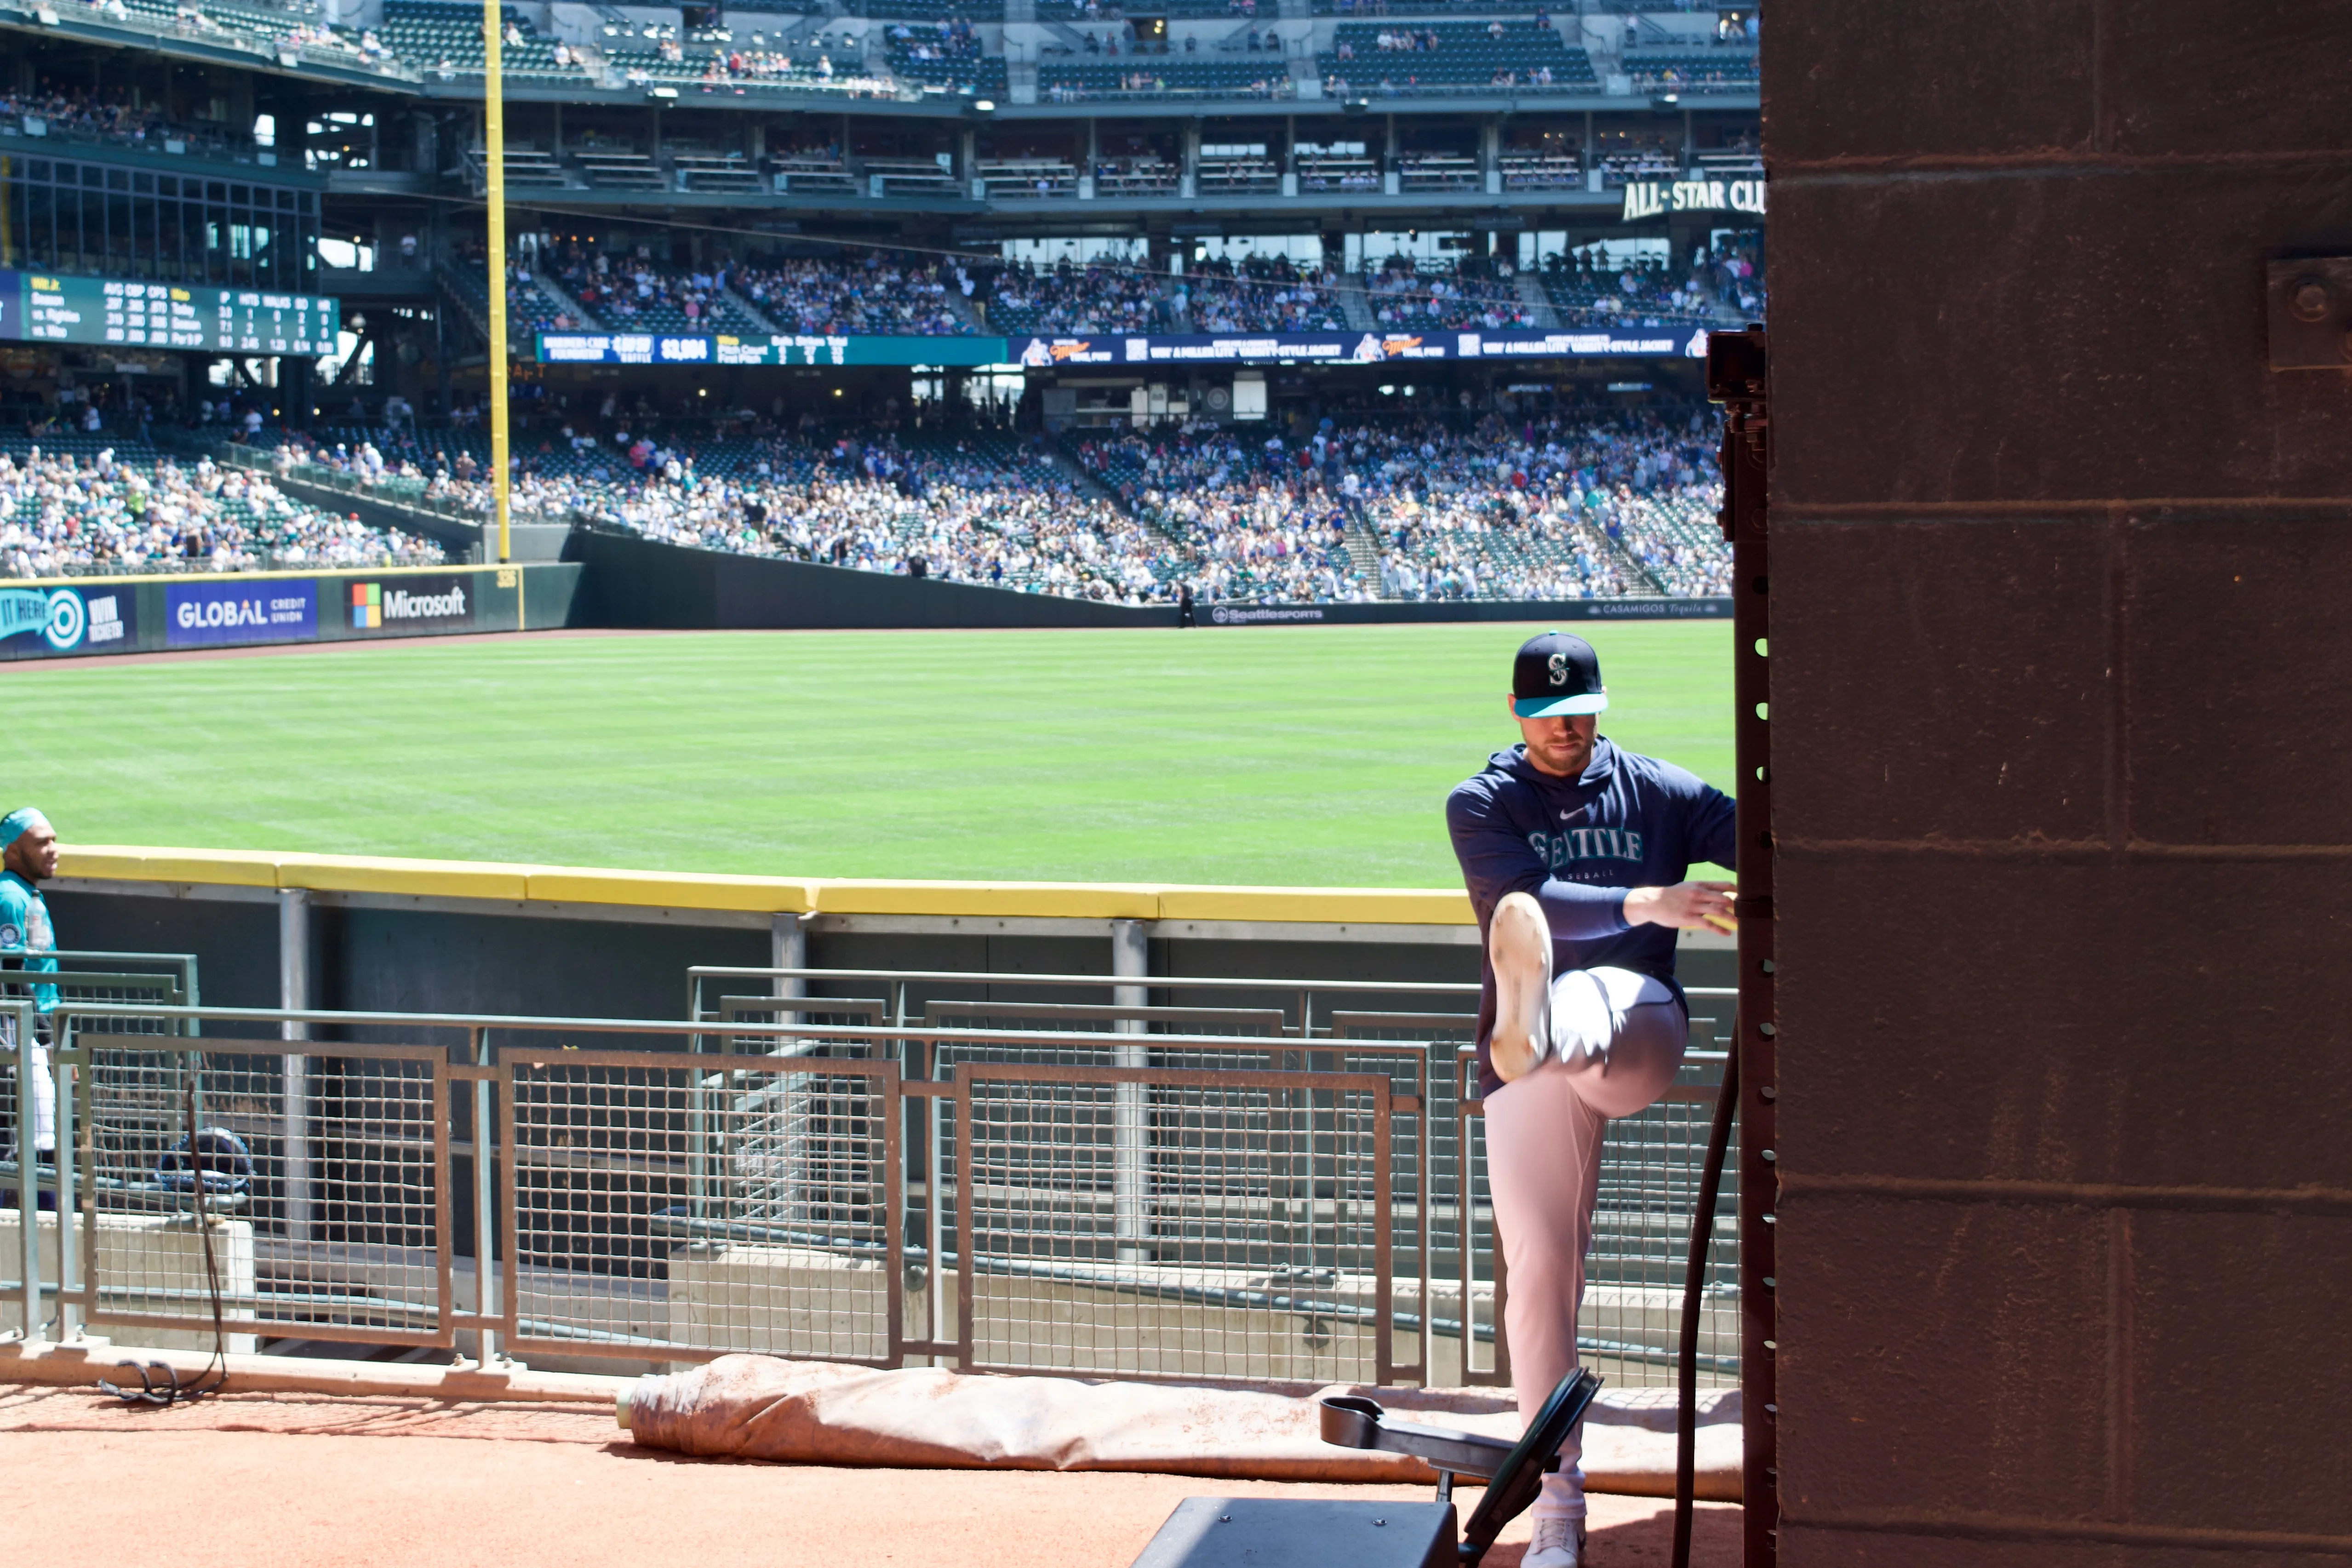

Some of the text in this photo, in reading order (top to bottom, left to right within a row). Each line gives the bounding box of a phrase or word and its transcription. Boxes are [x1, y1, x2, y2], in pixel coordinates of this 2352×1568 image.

[103, 282, 167, 299] AVG OBP OPS
[31, 292, 64, 307] Season
[239, 293, 260, 307] HITS
[263, 296, 292, 309] WALKS
[171, 302, 195, 318] Today
[247, 308, 253, 320] 1
[273, 309, 281, 322] 0
[298, 312, 305, 324] 2
[321, 313, 328, 326] 0
[172, 317, 201, 330] Season
[246, 322, 254, 335] 2
[275, 324, 281, 336] 1
[321, 327, 328, 339] 0
[771, 335, 794, 346] Balls
[795, 335, 825, 346] Strikes
[826, 336, 848, 346] Total
[1505, 343, 1512, 353] A
[1514, 343, 1546, 353] MILLER
[1571, 341, 1638, 352] VARSITY-STYLE
[1639, 341, 1673, 352] JACKET
[550, 349, 604, 360] FOUNDATION
[717, 345, 740, 355] Pitch
[741, 345, 768, 355] Count
[1173, 348, 1181, 358] A
[1181, 347, 1214, 358] MILLER
[1239, 346, 1306, 357] VARSITY-STYLE
[1307, 345, 1341, 356] JACKET
[717, 355, 738, 364] First
[738, 355, 761, 364] Pitch
[88, 595, 118, 624] WIN
[271, 597, 306, 610] CREDIT
[383, 586, 466, 619] Microsoft
[1603, 603, 1701, 616] CASAMIGOS Tequila
[3, 598, 46, 626] IT HERE
[177, 599, 268, 629] GLOBAL
[271, 611, 303, 624] UNION
[88, 620, 124, 642] TICKETS!
